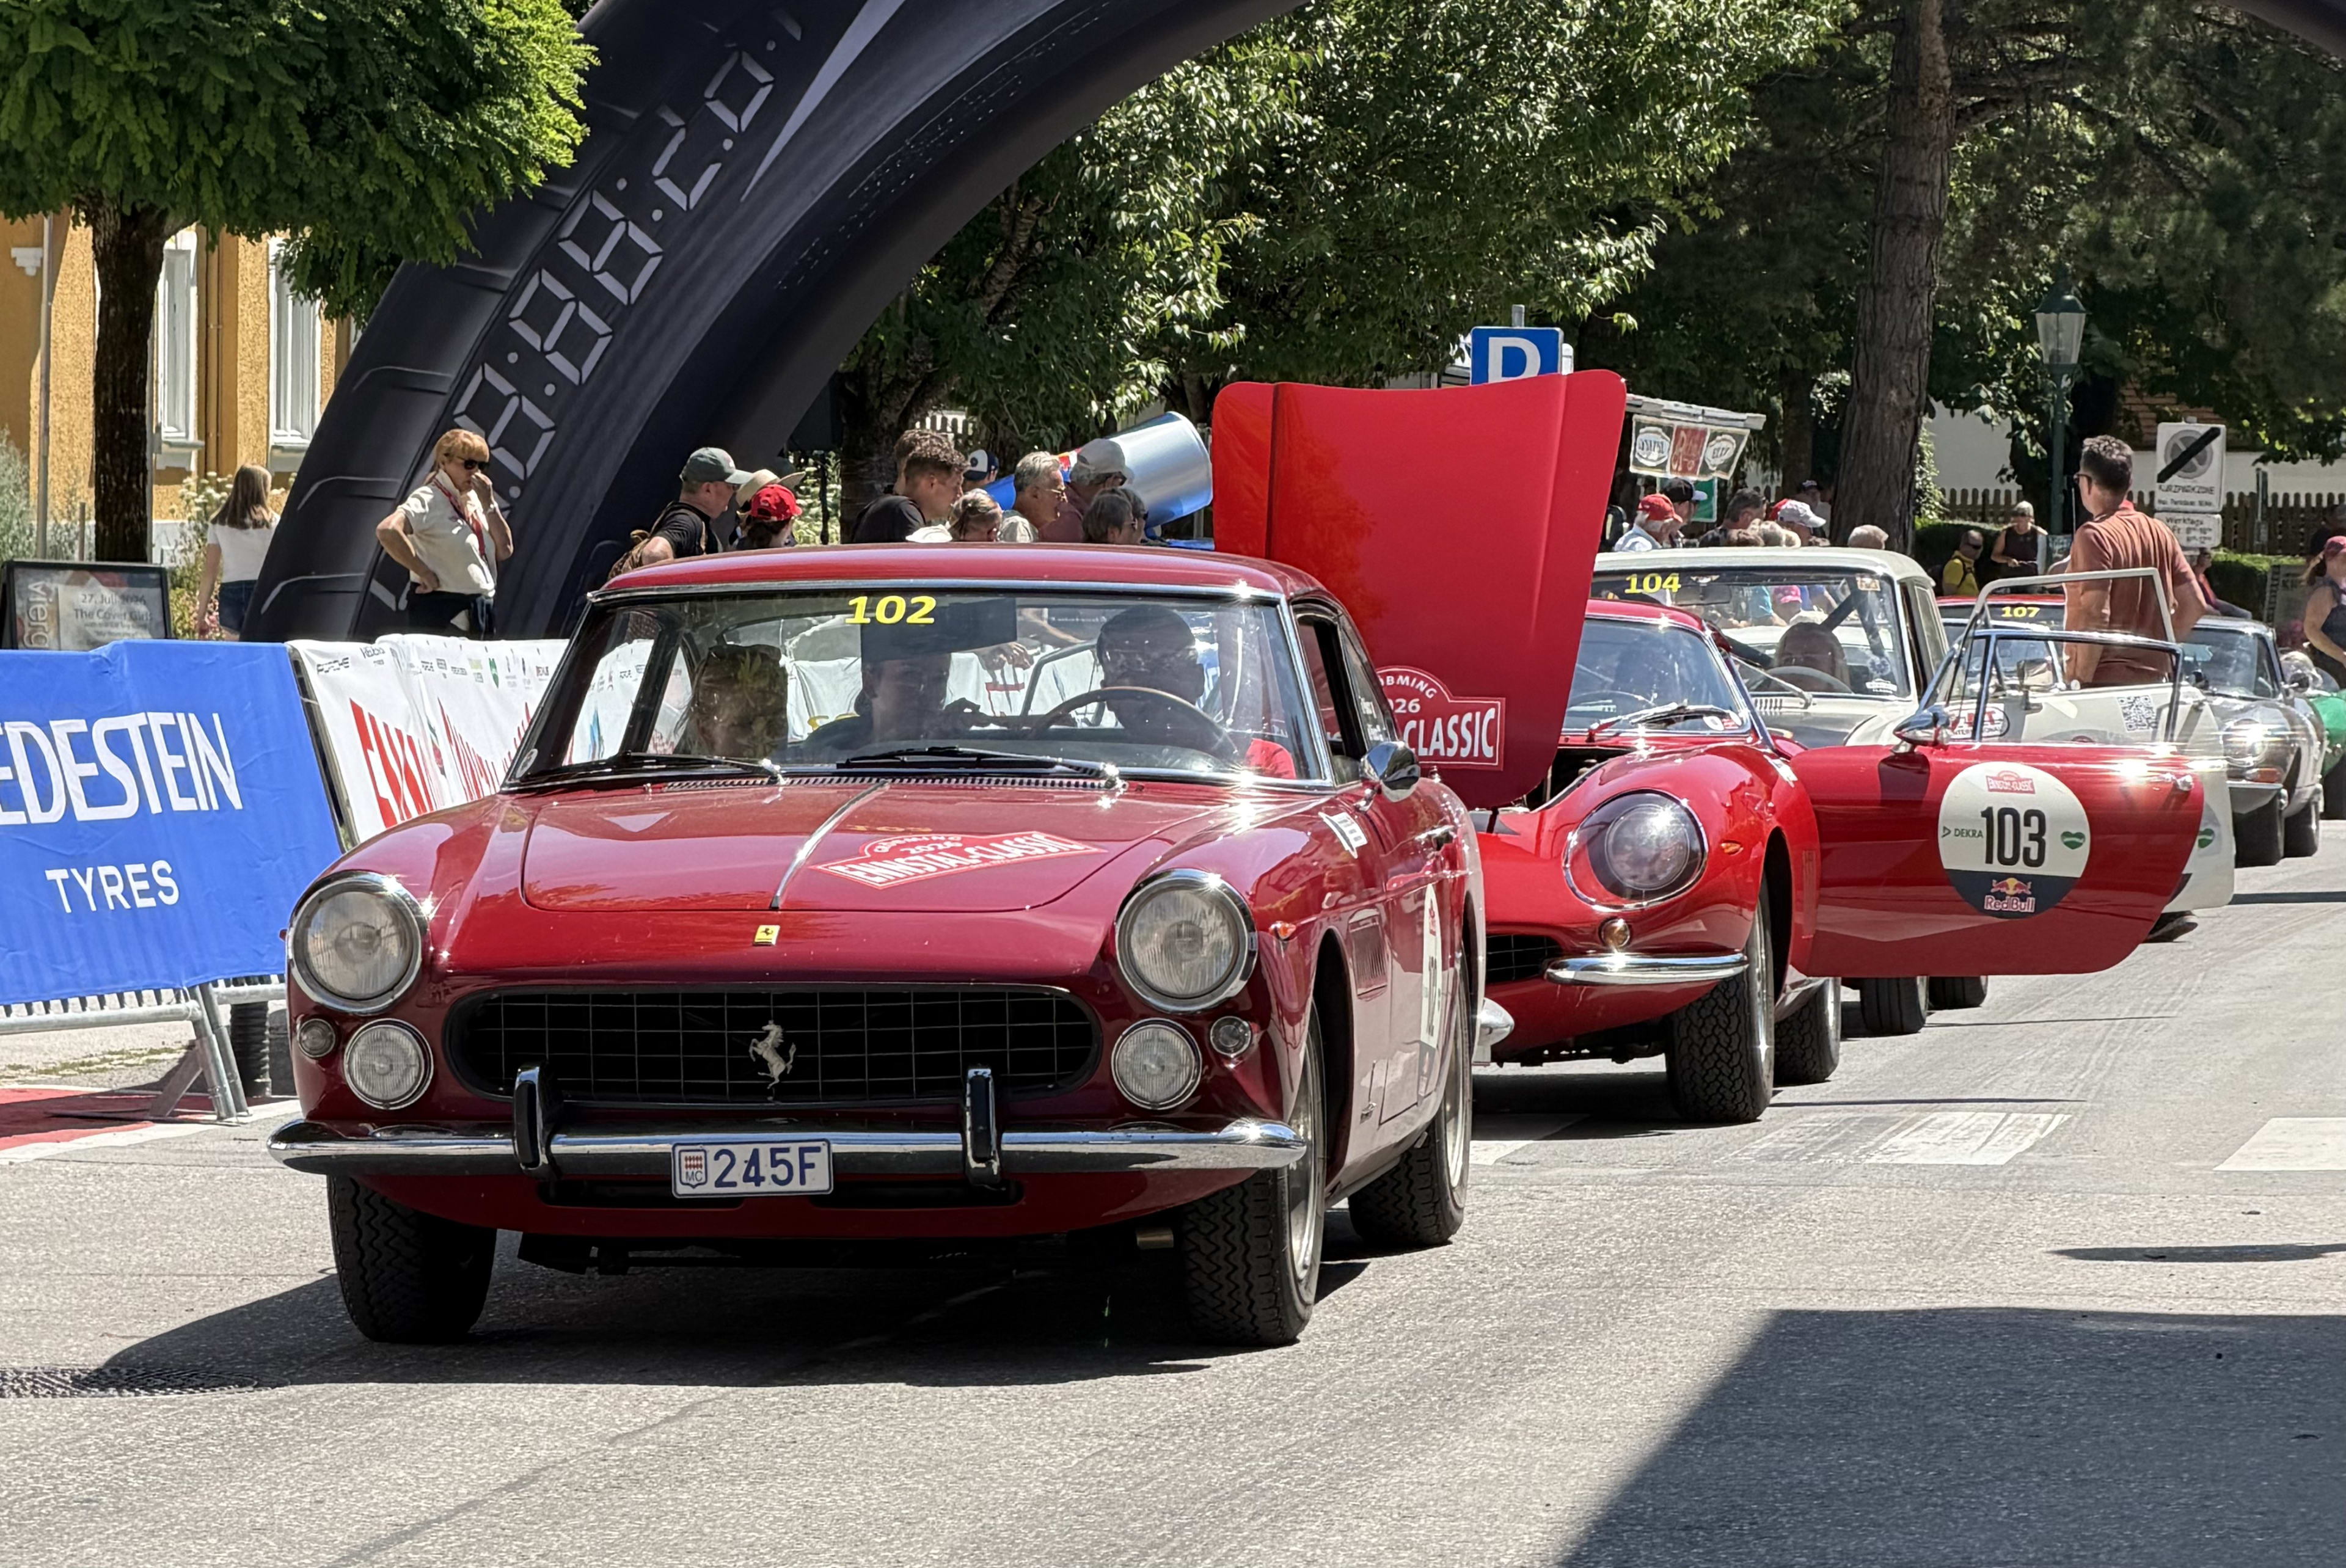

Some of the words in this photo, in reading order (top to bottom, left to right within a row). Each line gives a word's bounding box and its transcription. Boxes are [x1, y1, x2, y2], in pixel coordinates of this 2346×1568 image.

[1488, 337, 1541, 384] P
[1624, 573, 1681, 593] 104
[846, 595, 937, 624] 102
[2001, 606, 2041, 618] 107
[1403, 707, 1496, 758] CLASSIC
[1954, 828, 1983, 838] DEKRA
[1981, 806, 2046, 867] 103
[900, 841, 963, 855] 2026
[46, 860, 179, 913] TYRES
[1984, 895, 2011, 911] Red
[2011, 896, 2035, 913] Bull
[685, 1171, 703, 1183] MC
[714, 1146, 821, 1188] 245F
